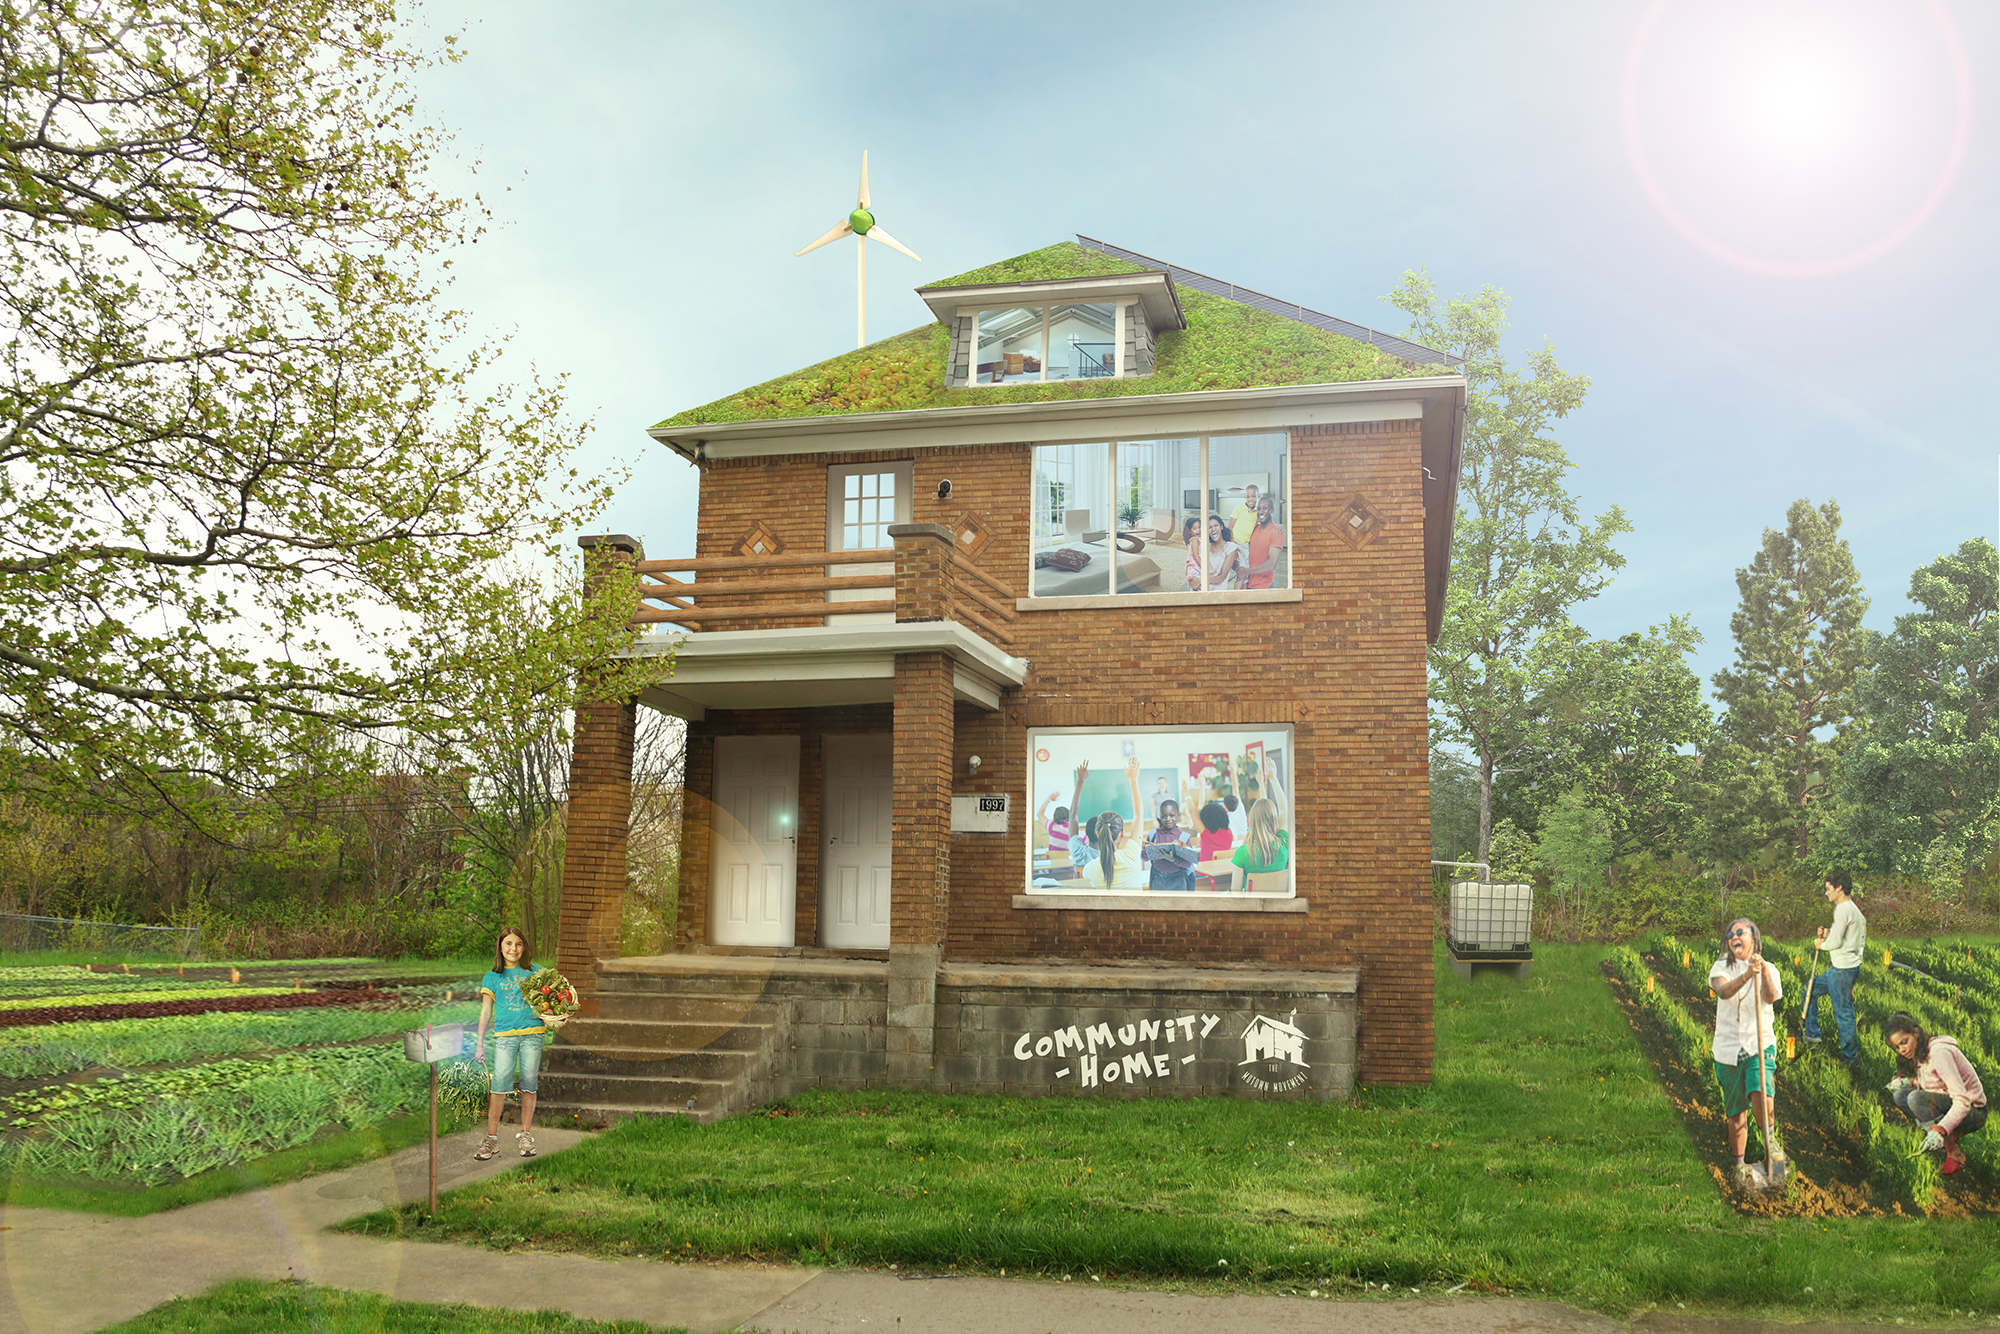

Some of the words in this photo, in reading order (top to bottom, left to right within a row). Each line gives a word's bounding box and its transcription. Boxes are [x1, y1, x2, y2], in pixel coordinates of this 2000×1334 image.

[981, 799, 1005, 811] 1997
[1268, 1064, 1278, 1073] THE
[1241, 1070, 1270, 1092] MOTOWN
[1273, 1071, 1308, 1093] MOVEMENT
